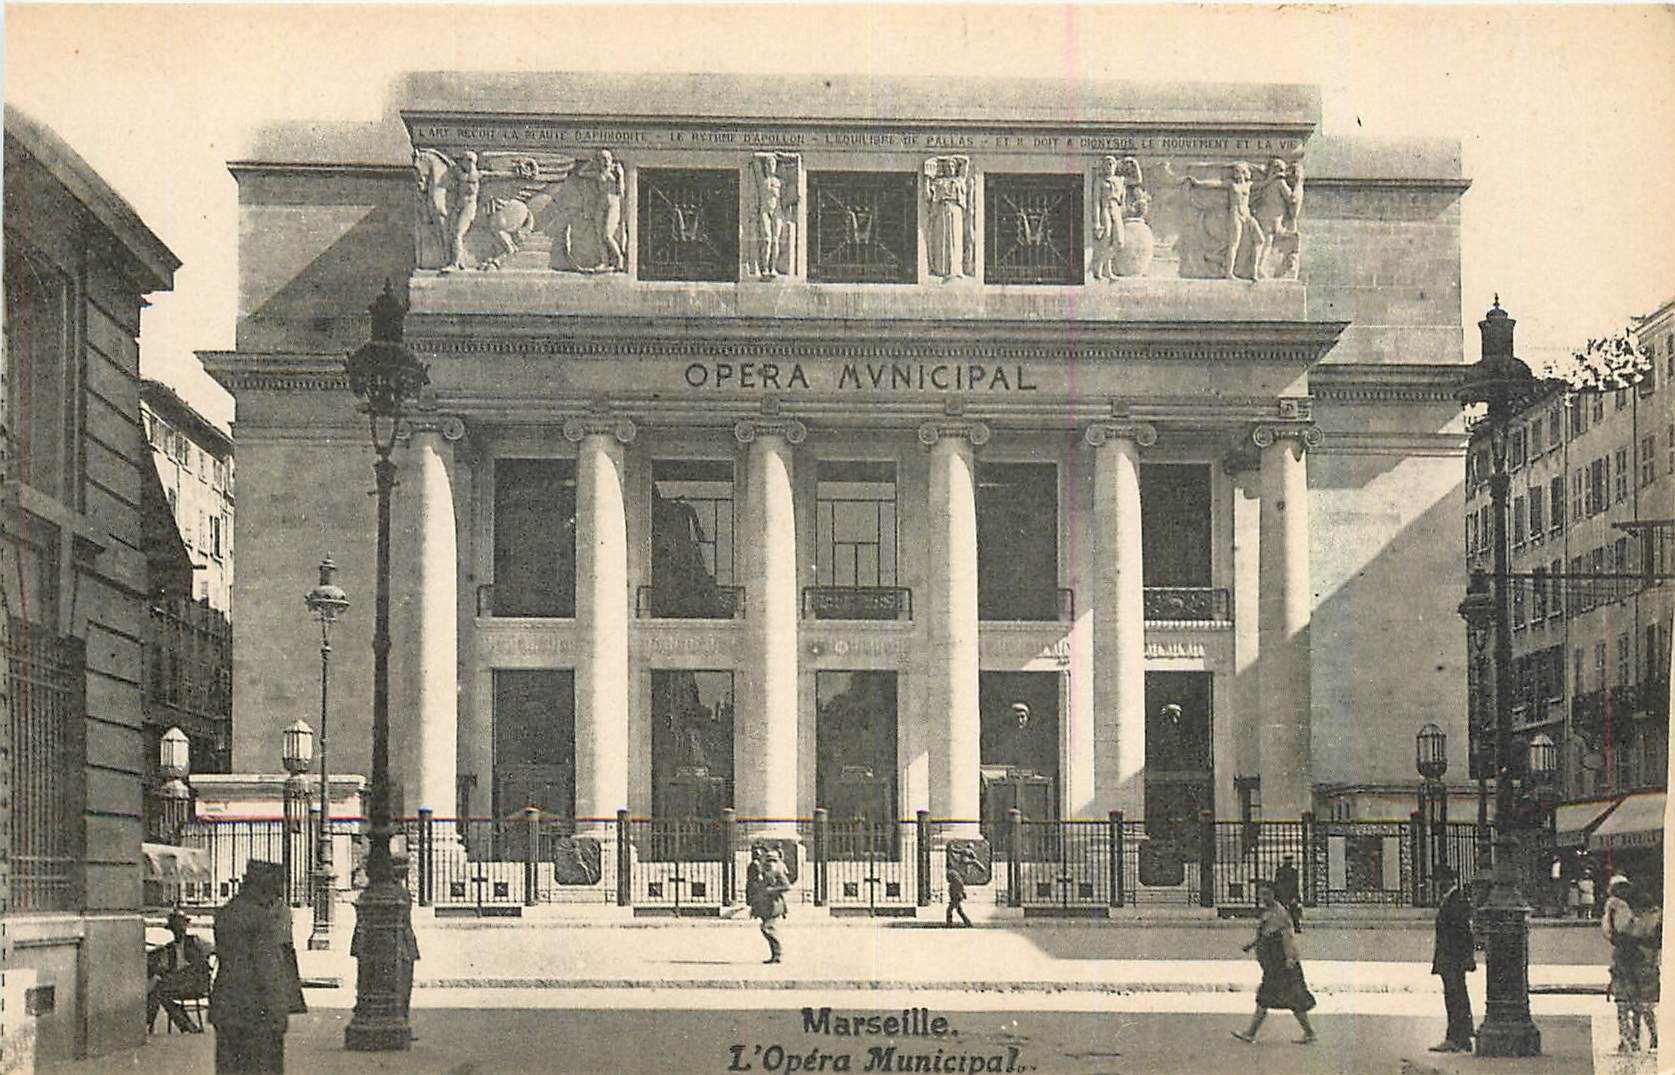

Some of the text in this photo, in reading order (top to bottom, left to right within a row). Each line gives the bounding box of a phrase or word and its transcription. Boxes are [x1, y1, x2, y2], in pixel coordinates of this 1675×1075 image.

[926, 135, 974, 147] PALLAS
[1162, 139, 1229, 150] MOUVEMENT
[1236, 139, 1250, 149] ET
[1257, 139, 1273, 150] LA
[685, 362, 1037, 390] OPERA MVNICIPAL
